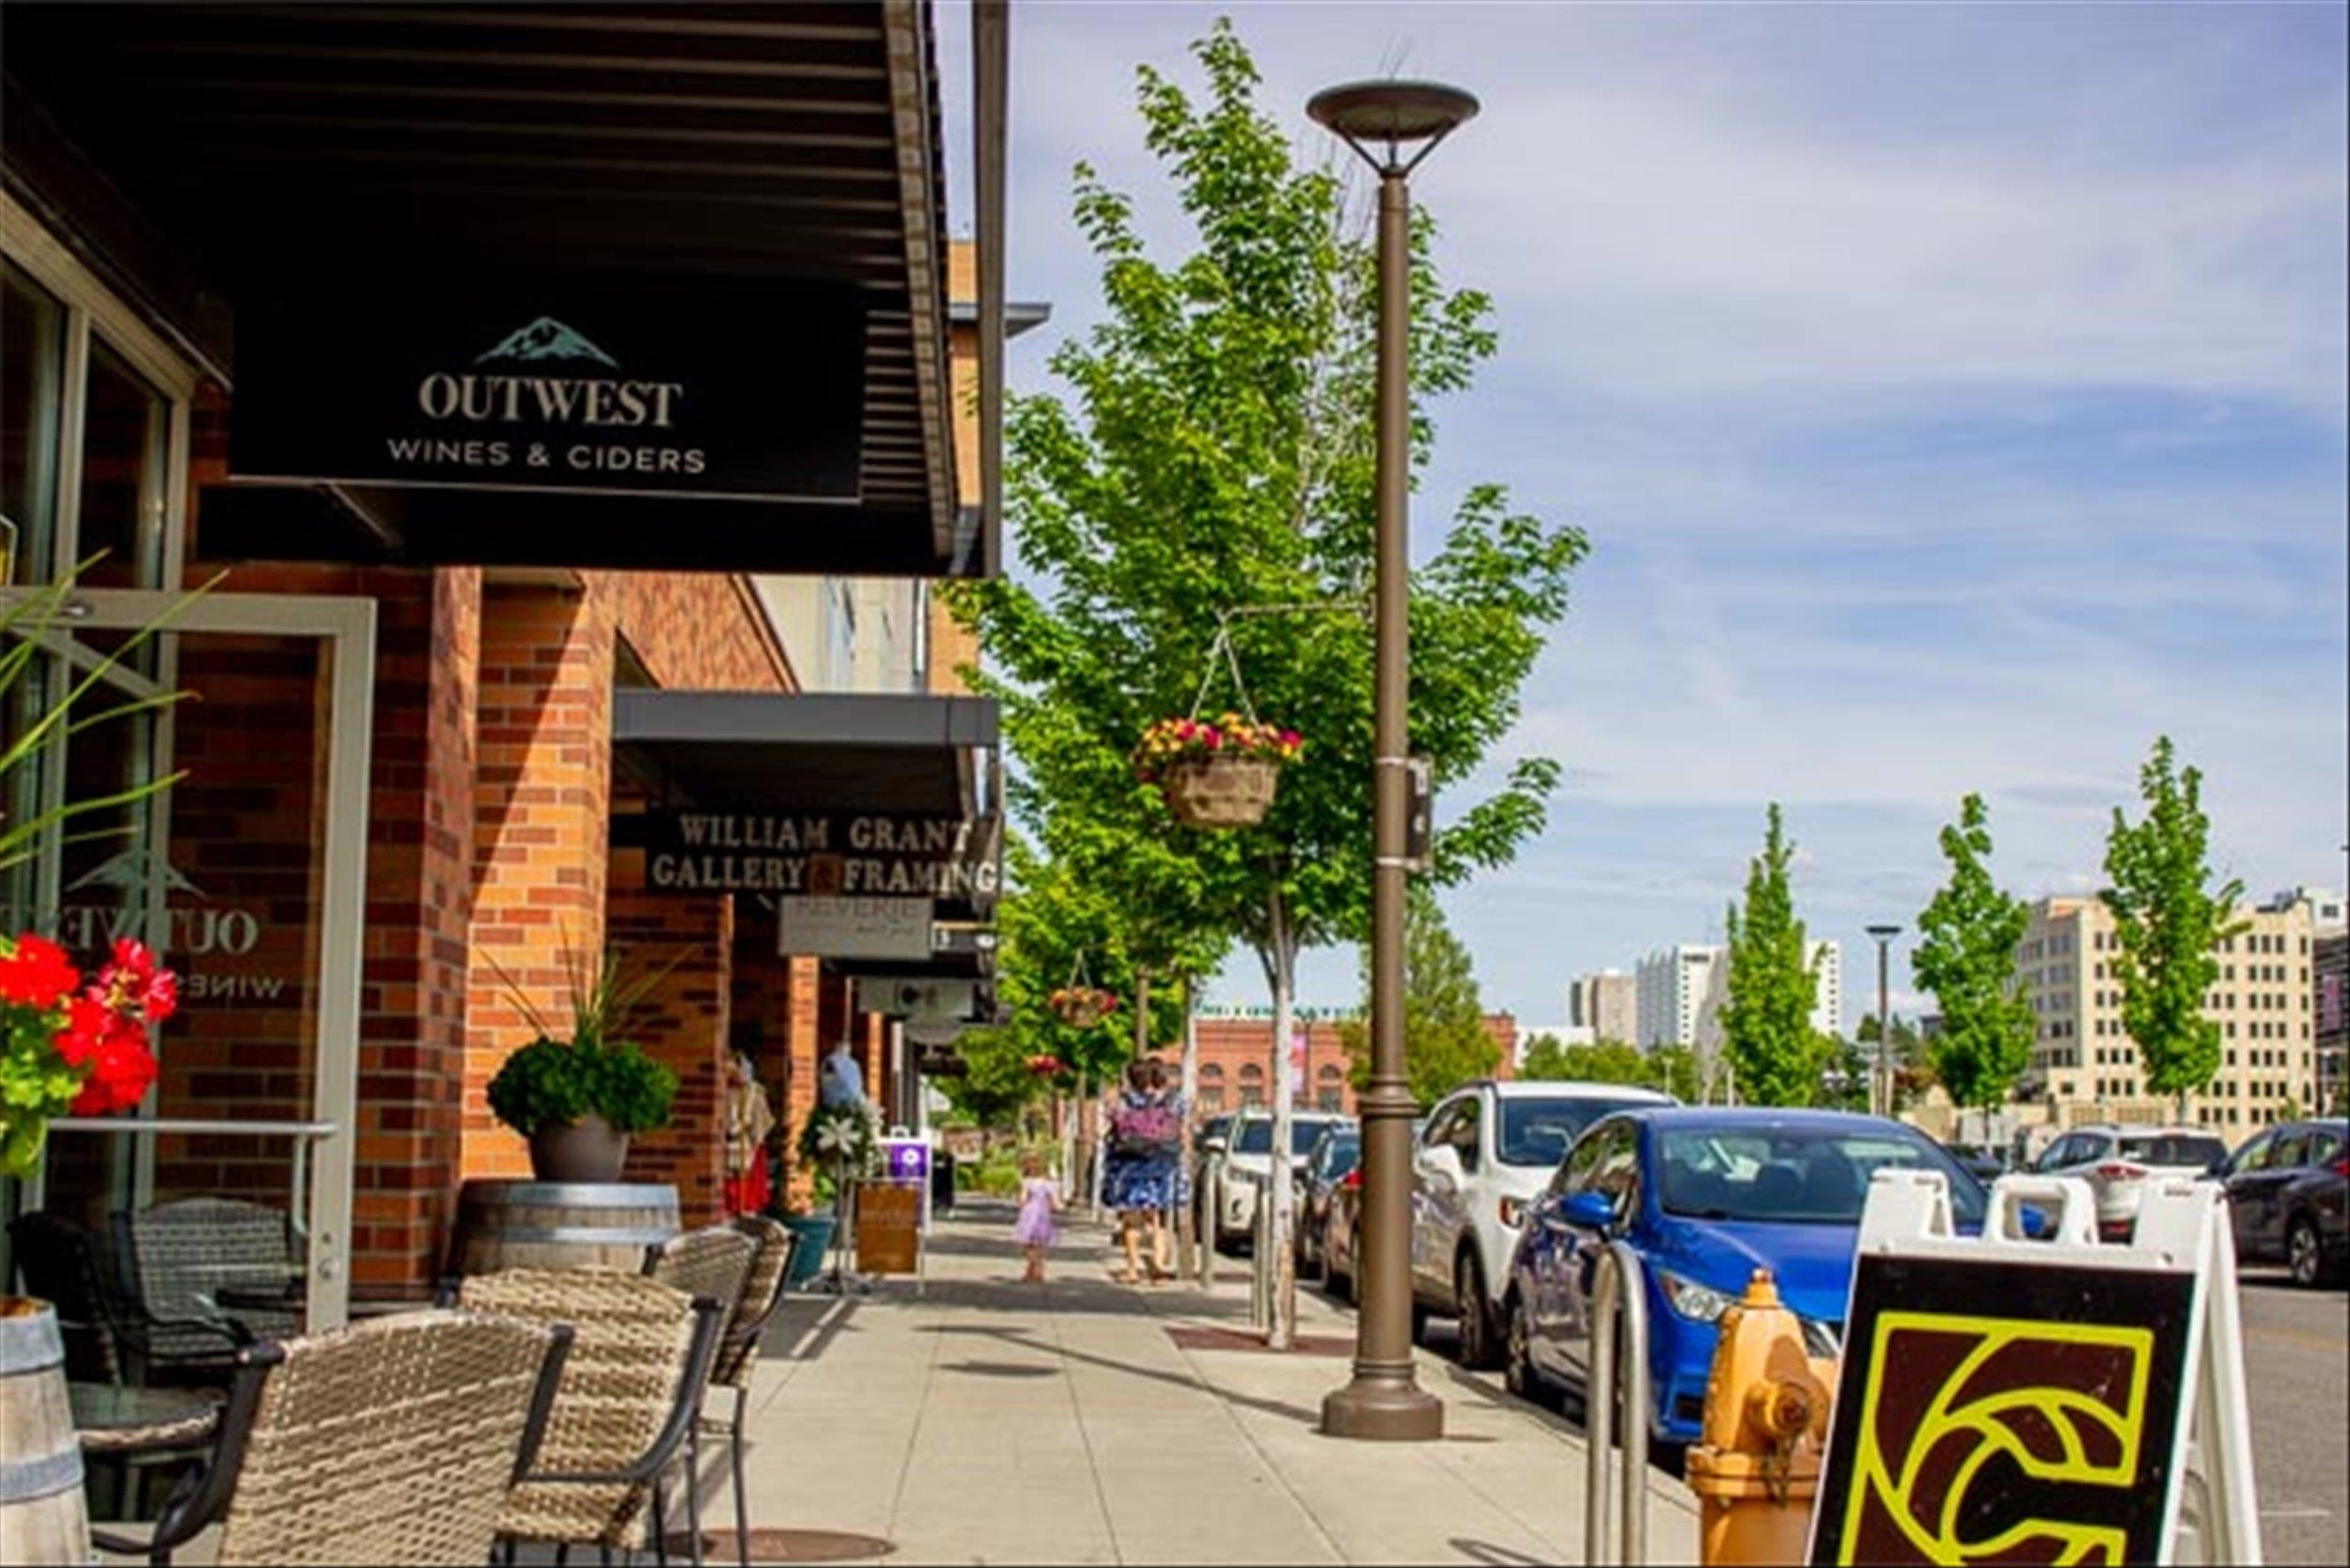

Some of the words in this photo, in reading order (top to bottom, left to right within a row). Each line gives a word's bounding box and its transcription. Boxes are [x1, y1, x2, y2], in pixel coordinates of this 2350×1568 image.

[418, 372, 683, 427] OUTWEST
[387, 438, 509, 466] WINES
[527, 443, 550, 467] &
[567, 446, 706, 474] CIDERS
[679, 814, 828, 848] WILLIAM
[849, 817, 972, 853] GRANT
[652, 855, 806, 888] GALLERY
[843, 859, 997, 893] FRAMING
